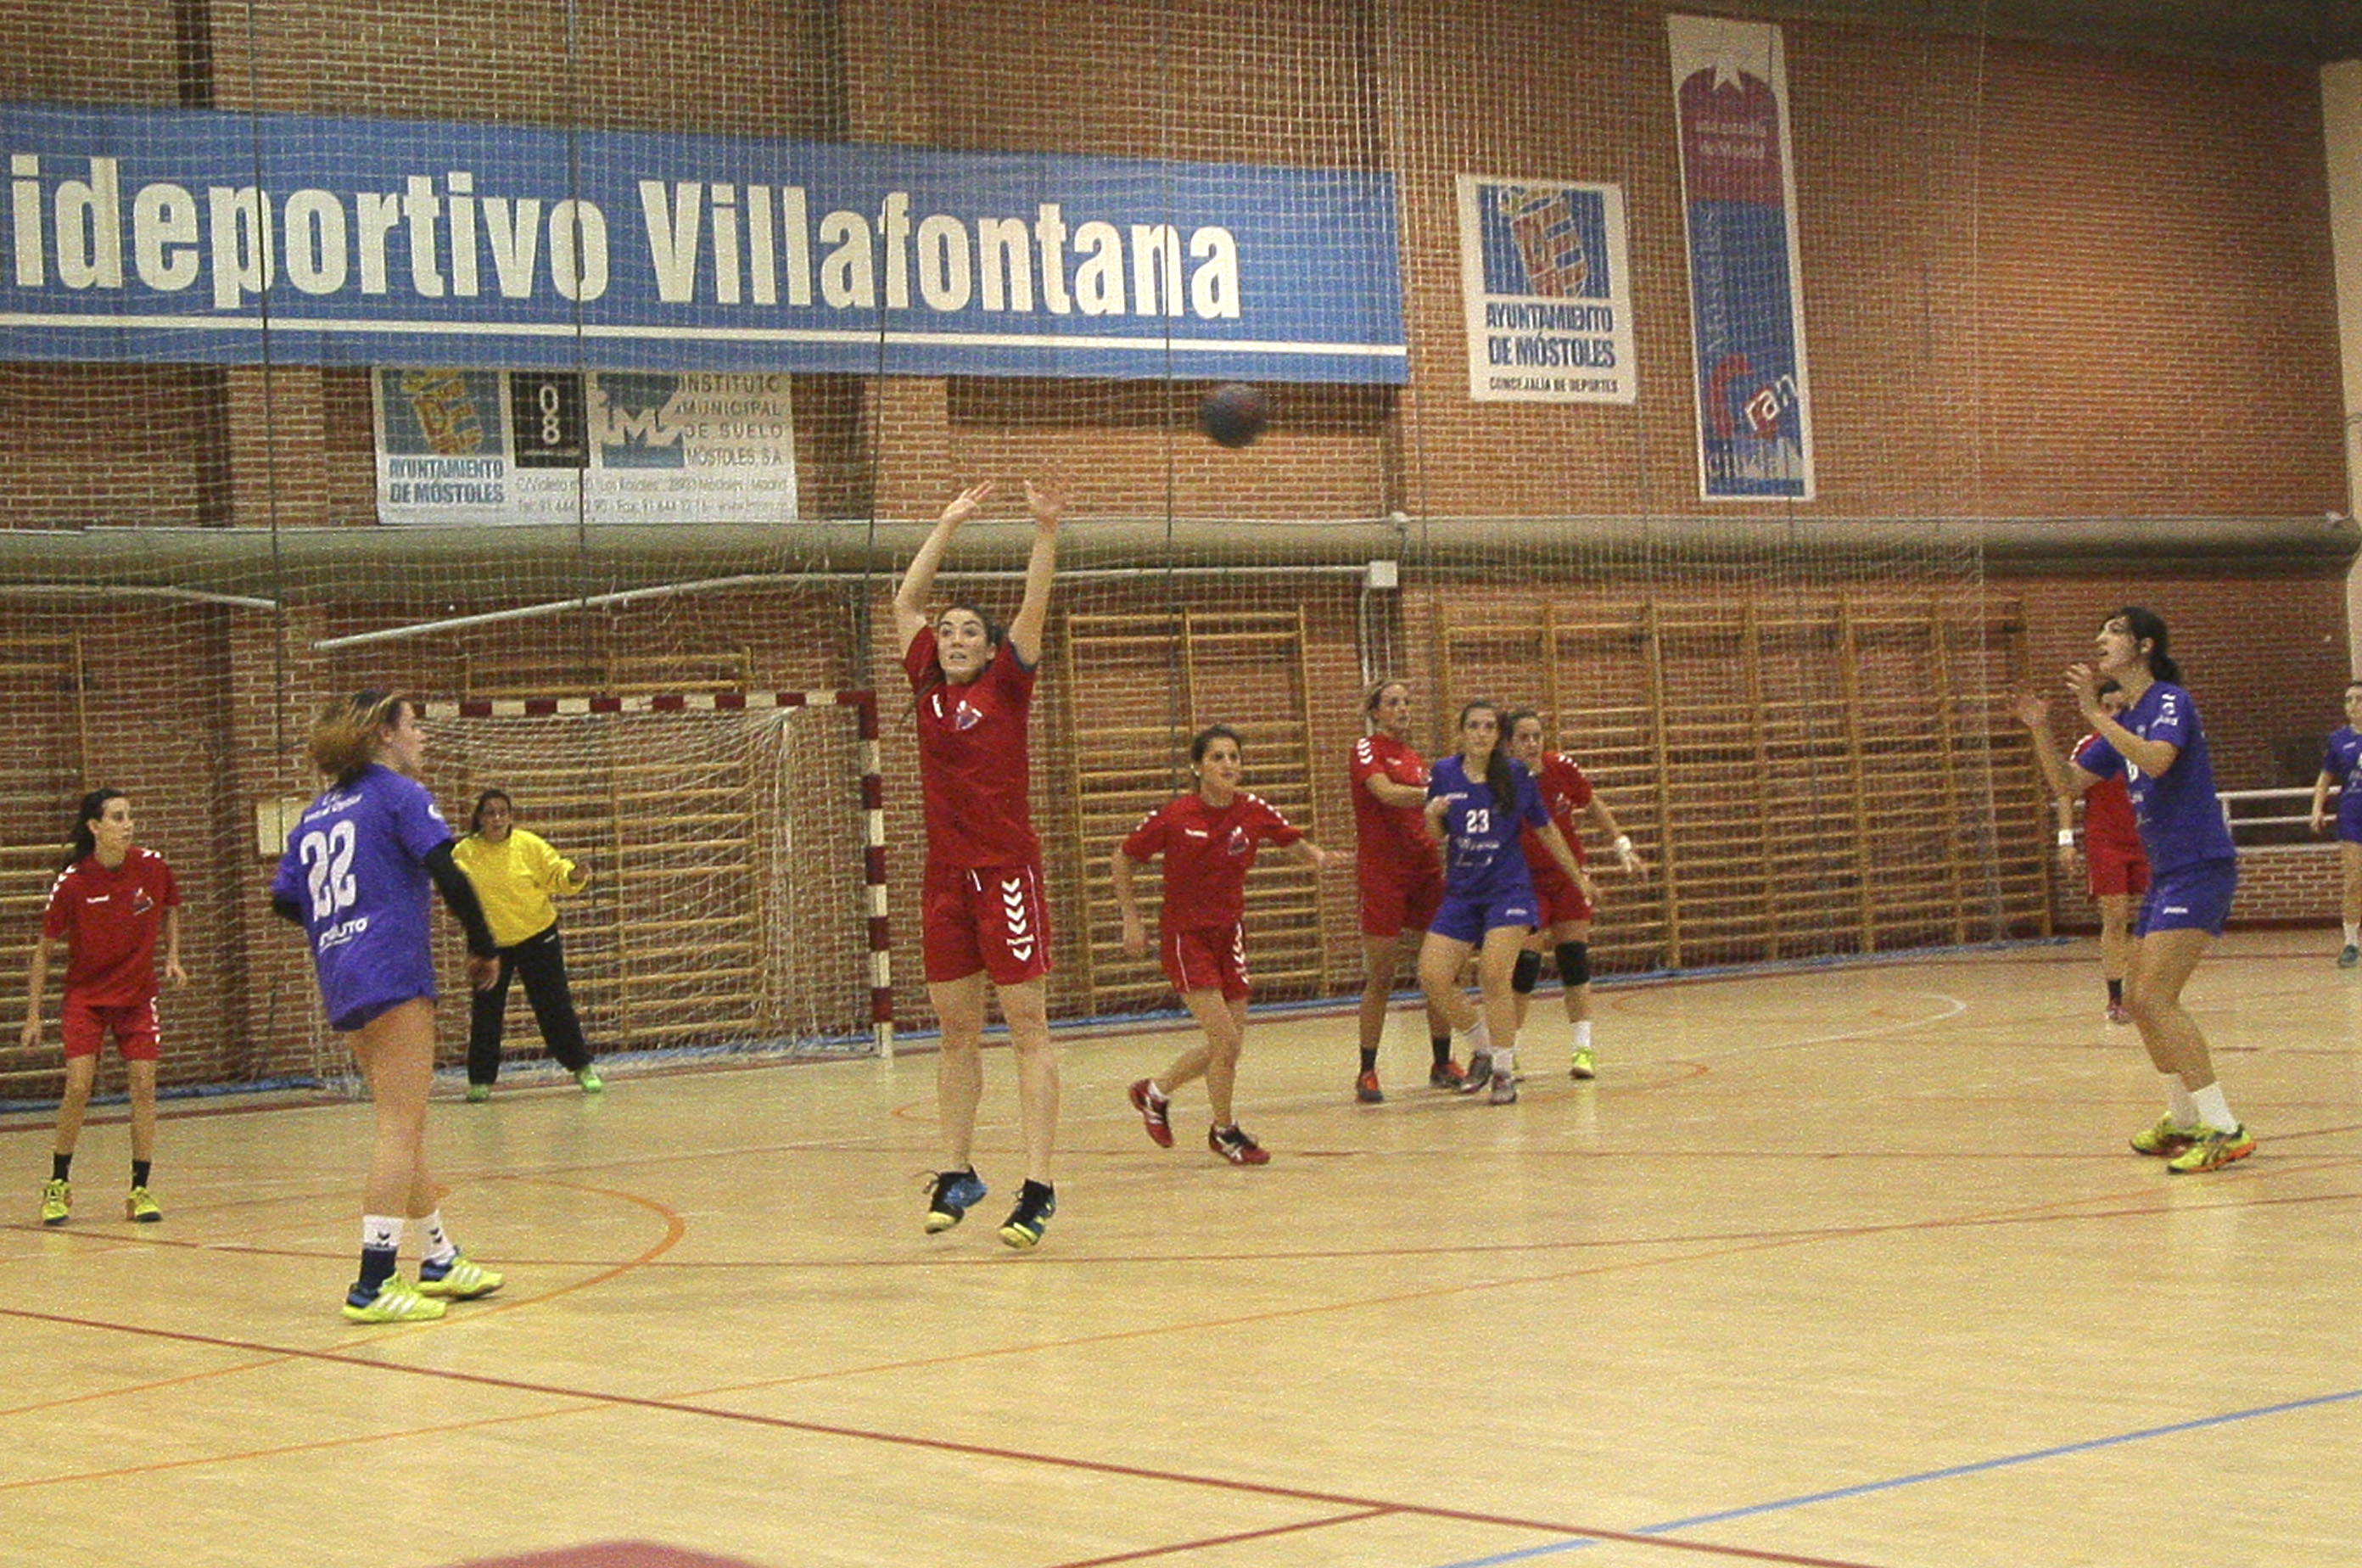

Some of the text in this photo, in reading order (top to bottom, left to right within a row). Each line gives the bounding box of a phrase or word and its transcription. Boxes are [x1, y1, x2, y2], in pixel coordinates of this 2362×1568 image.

[10, 154, 1240, 319] ideportivo Villafontana
[1486, 304, 1613, 332] AYUNTAMIENTO
[1488, 332, 1616, 368] DE MÓSTOLES
[719, 423, 782, 438] SUELO
[389, 458, 503, 478] AYUNTAMIENTO
[390, 479, 504, 503] DE MÓSTOLES
[1466, 809, 1490, 833] 23
[299, 819, 356, 922] 22
